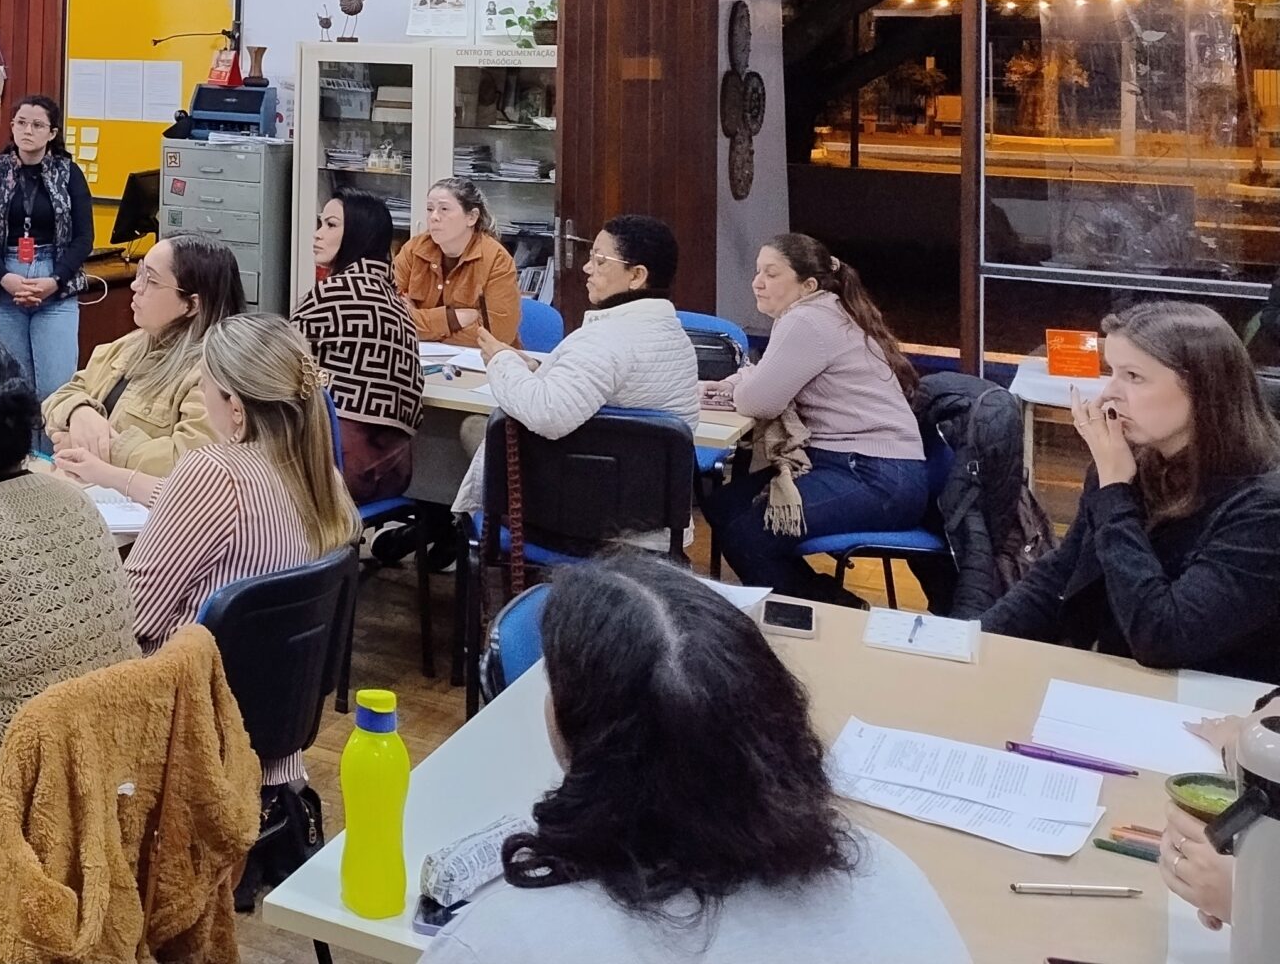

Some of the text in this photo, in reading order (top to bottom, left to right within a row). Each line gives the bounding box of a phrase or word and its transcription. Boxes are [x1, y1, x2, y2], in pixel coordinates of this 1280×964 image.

[455, 49, 556, 58] CENTRO DE DOCUMENTAÇÃO
[478, 57, 522, 65] PEDAGÓGICA
